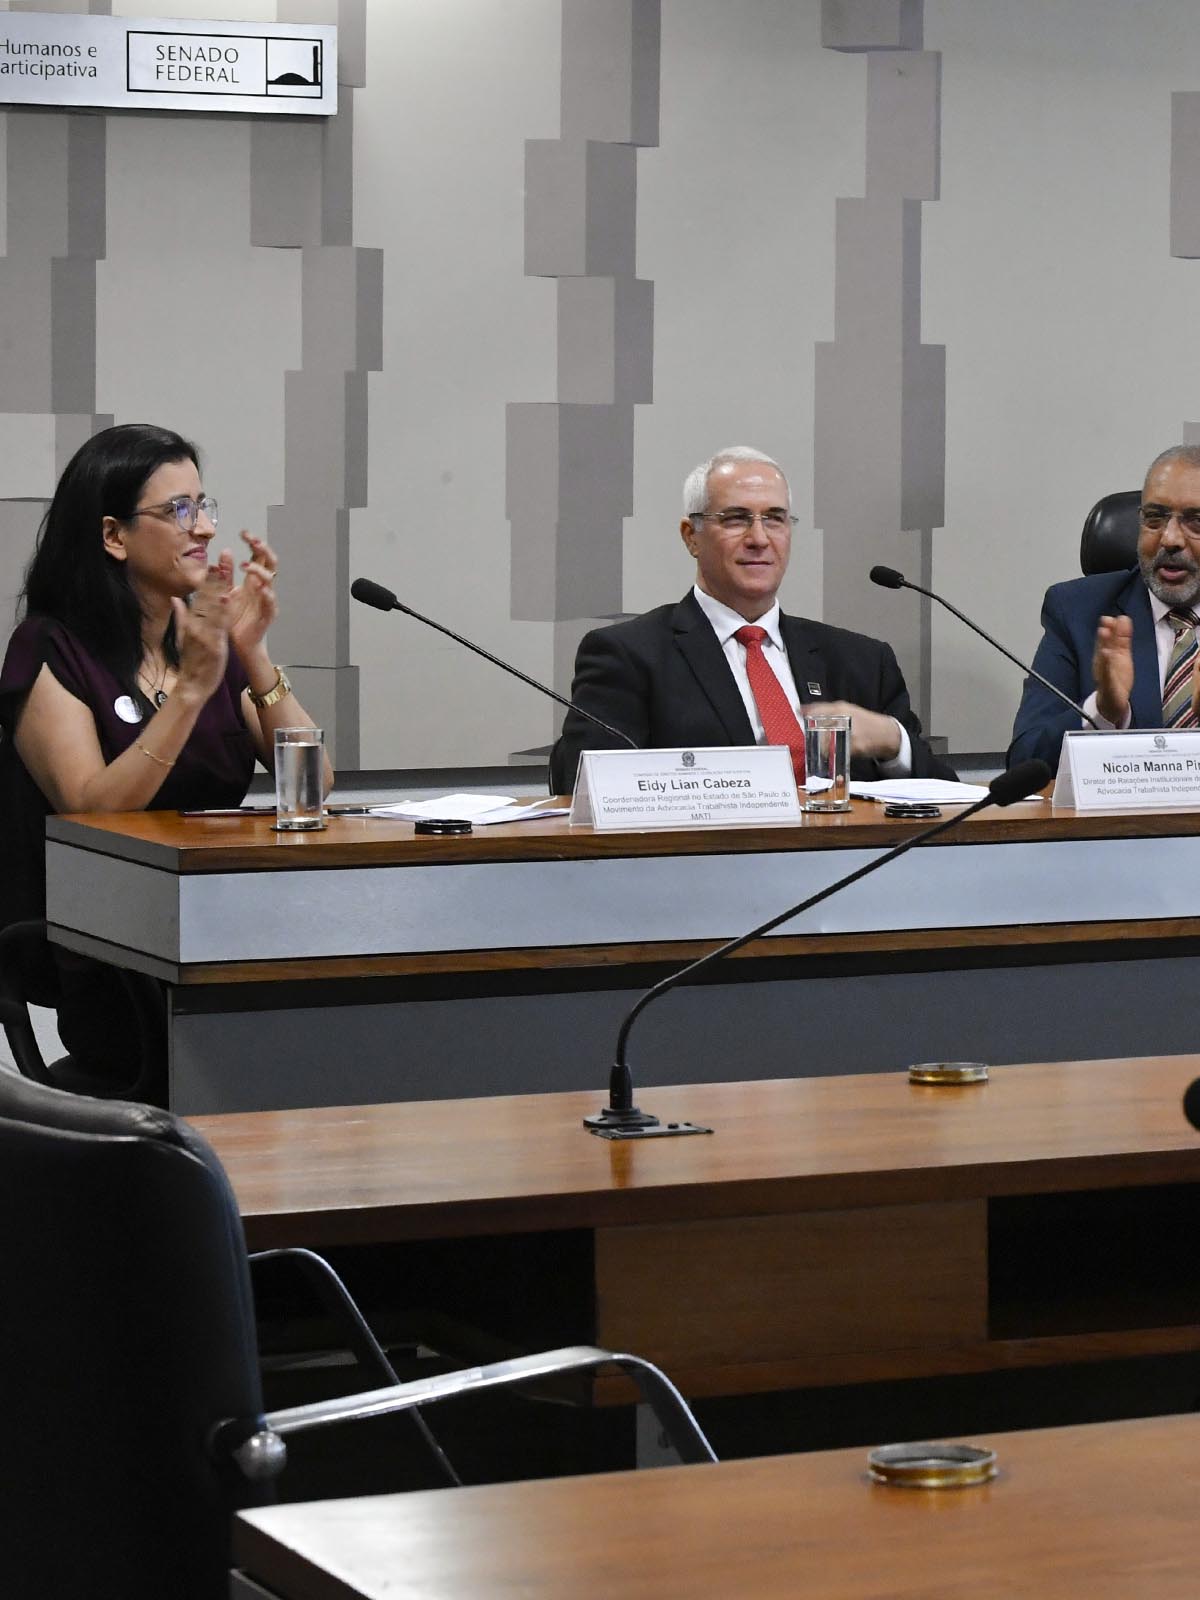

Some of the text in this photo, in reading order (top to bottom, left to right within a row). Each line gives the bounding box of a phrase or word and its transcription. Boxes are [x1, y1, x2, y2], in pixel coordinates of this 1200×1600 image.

[88, 46, 97, 58] e
[155, 44, 239, 64] SENADO
[0, 59, 97, 81] articipativa
[155, 64, 240, 84] FEDERAL
[1103, 762, 1140, 773] Nicola
[1143, 761, 1183, 772] Manna
[637, 777, 751, 793] Eidy Lian Cabeza
[657, 793, 690, 803] Regional
[703, 792, 729, 800] Estado
[603, 805, 644, 813] Movimento
[645, 804, 655, 812] da
[697, 802, 738, 810] Trabalhista
[740, 801, 789, 809] Independente
[691, 812, 711, 821] MATI
